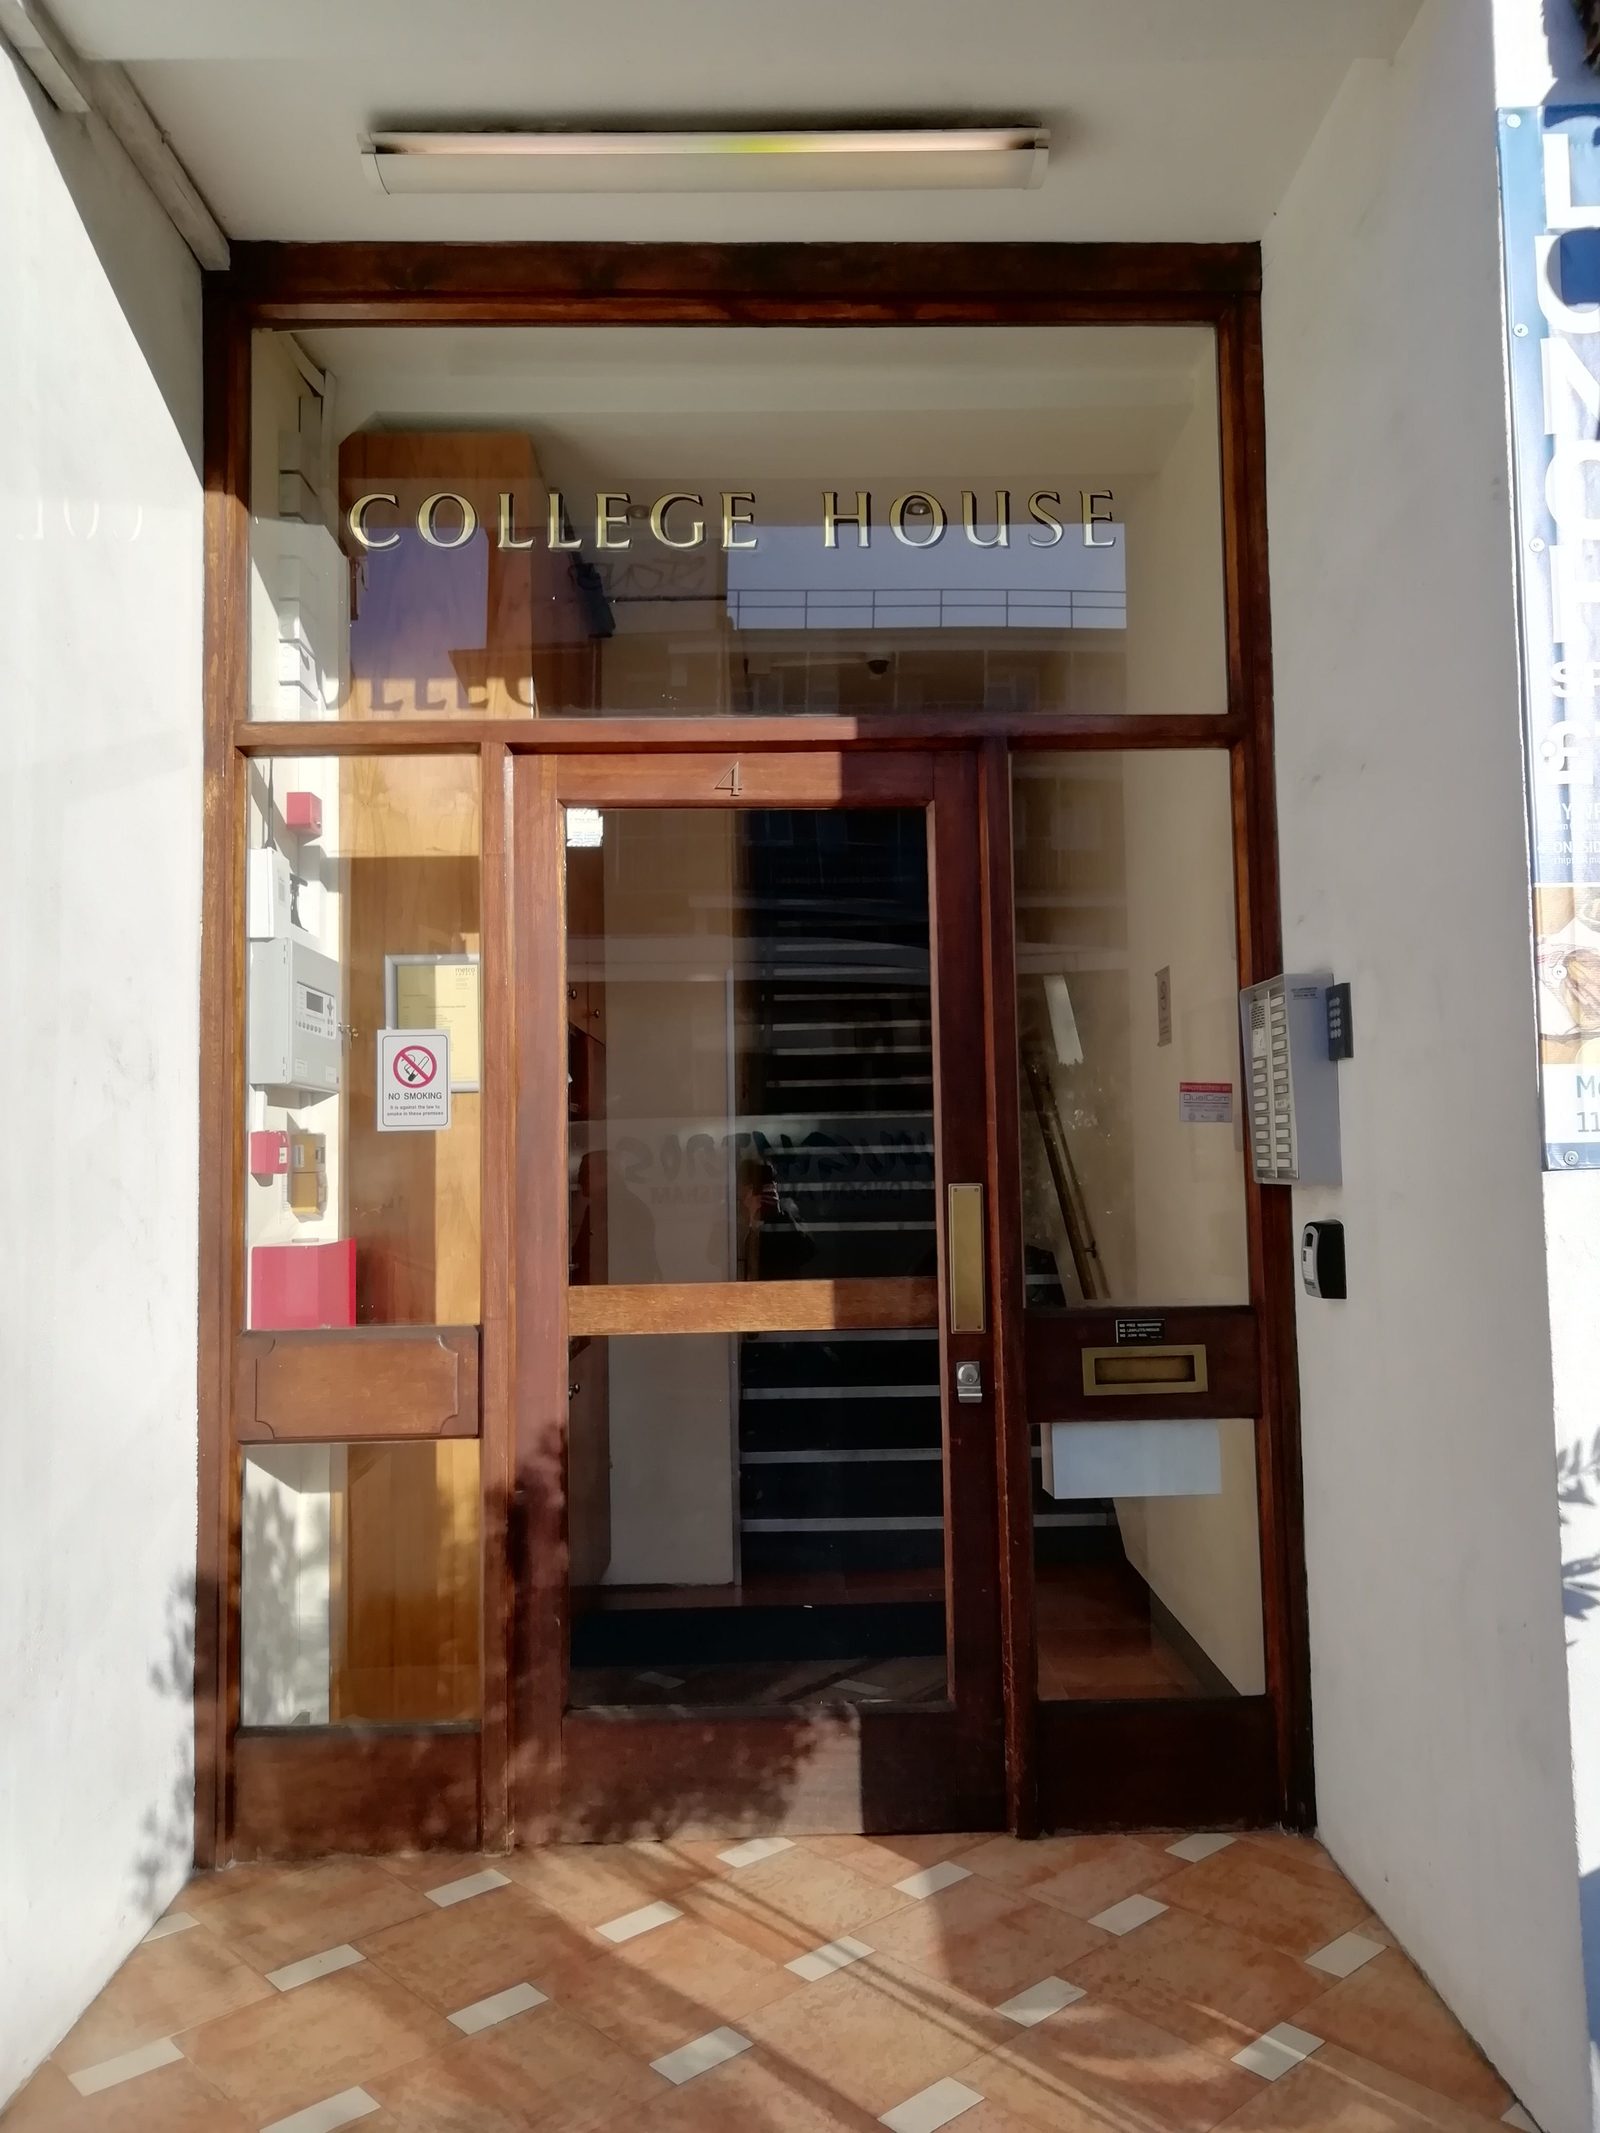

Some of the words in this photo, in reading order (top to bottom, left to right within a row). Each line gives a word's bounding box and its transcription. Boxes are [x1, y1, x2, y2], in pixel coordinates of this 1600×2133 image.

[348, 491, 758, 550] COLLEGE
[822, 489, 1117, 549] HOUSE
[713, 761, 743, 797] 4
[388, 1092, 401, 1100] NO
[403, 1092, 442, 1100] SMOKING
